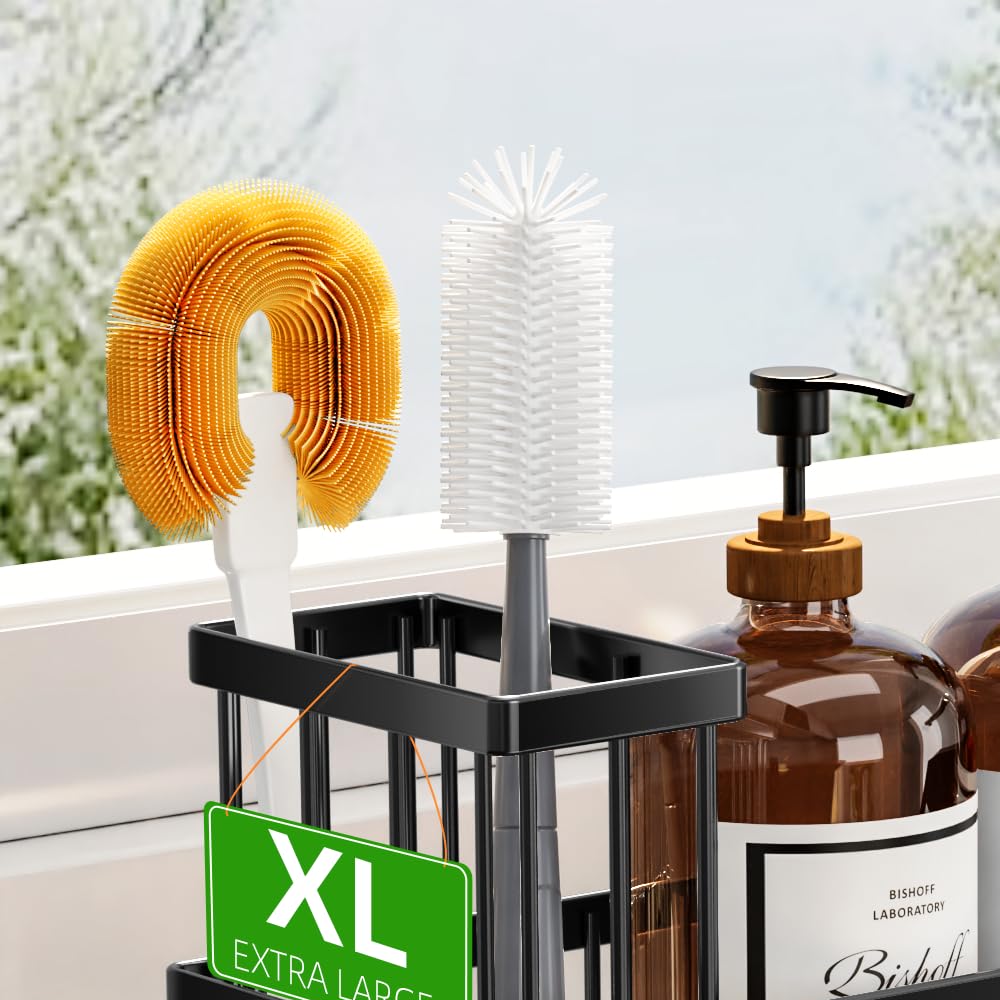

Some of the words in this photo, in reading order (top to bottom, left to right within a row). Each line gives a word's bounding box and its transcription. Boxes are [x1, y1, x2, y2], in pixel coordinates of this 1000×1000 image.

[266, 828, 407, 968] XL
[873, 900, 946, 921] LABORATORY
[889, 883, 936, 900] BISHOFF
[234, 938, 329, 995] EXTRA
